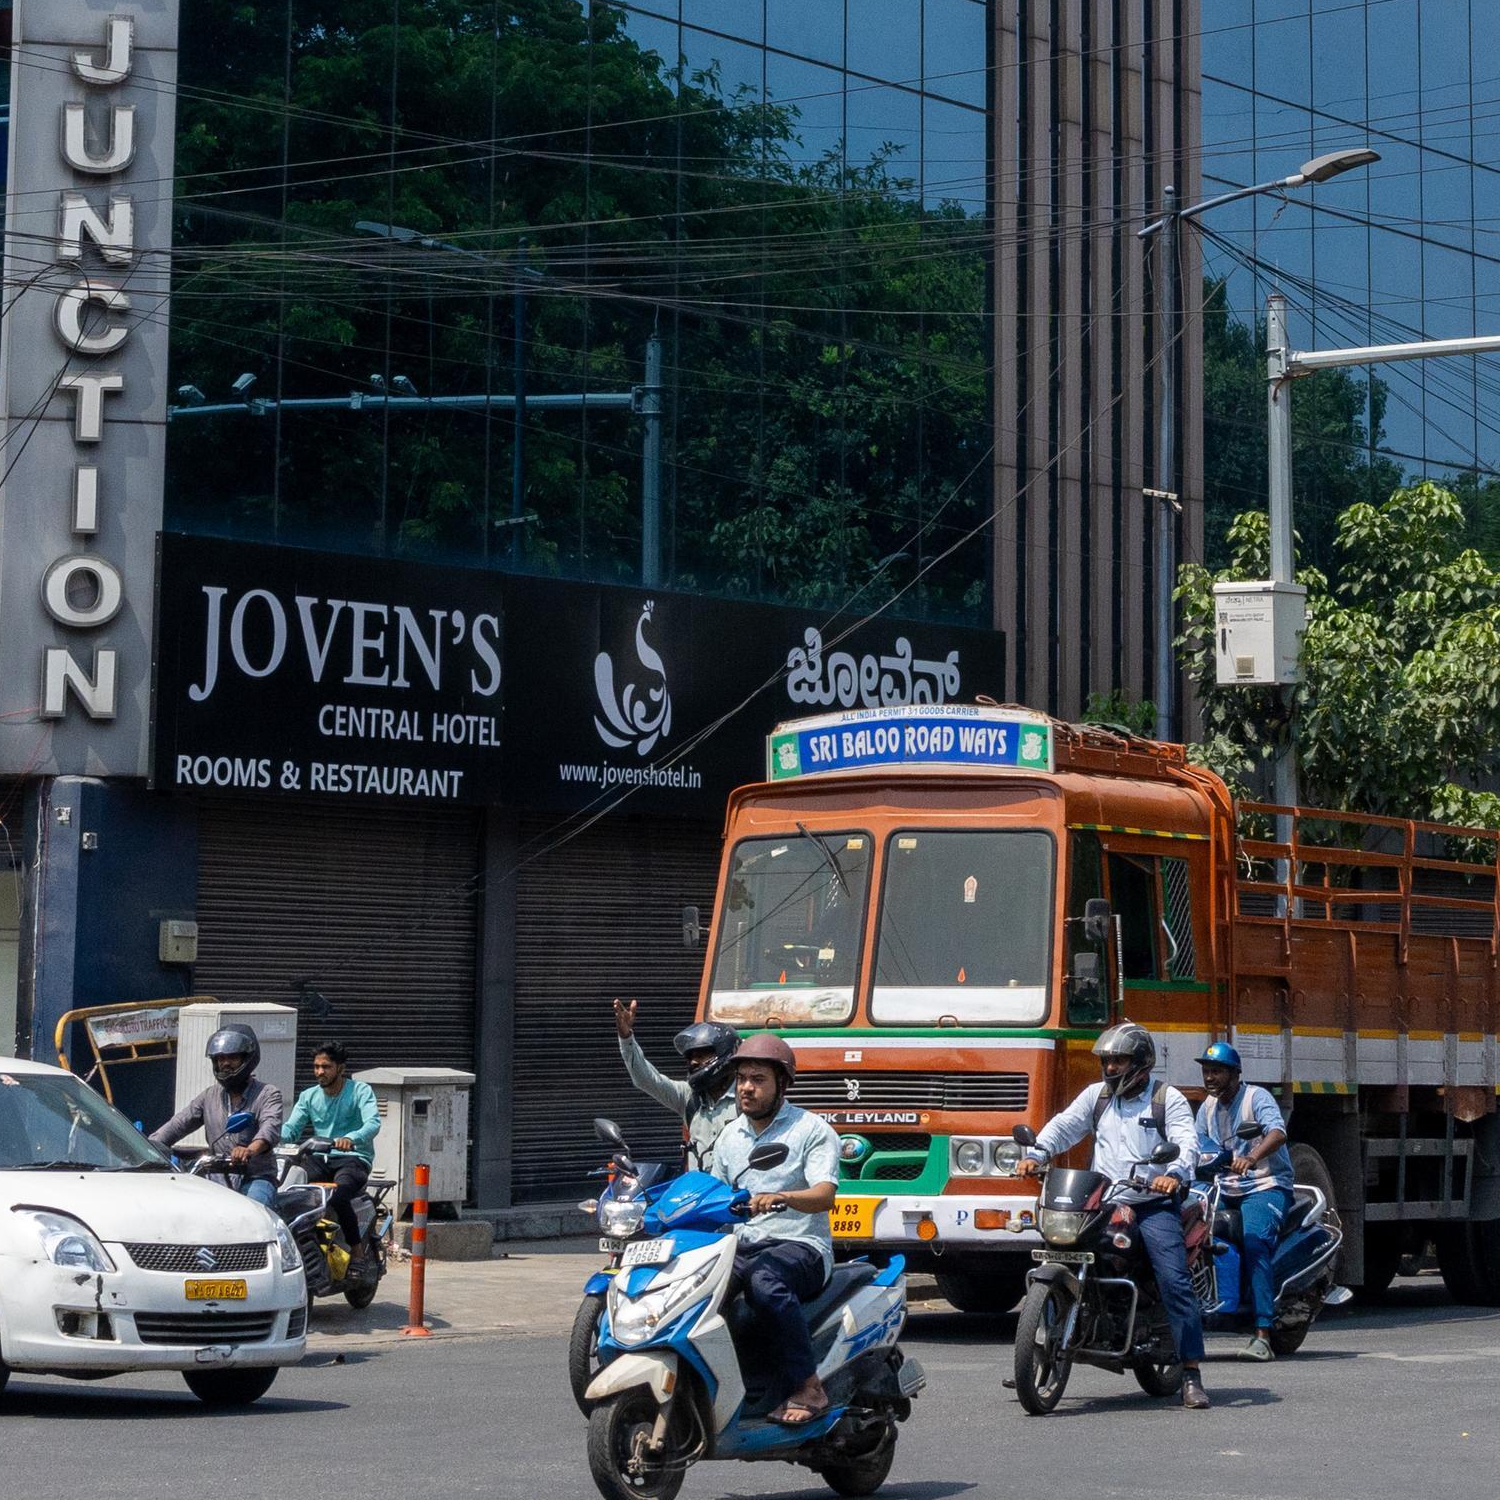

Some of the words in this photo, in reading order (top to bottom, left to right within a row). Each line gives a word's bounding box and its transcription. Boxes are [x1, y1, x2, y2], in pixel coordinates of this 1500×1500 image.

[39, 13, 137, 721] JUNCTION
[188, 585, 502, 702] JOVEN'S
[318, 703, 423, 742] CENTRAL
[432, 712, 501, 747] HOTEL
[857, 710, 877, 720] INDIA
[879, 707, 905, 718] PERMIT
[919, 706, 945, 716] GOODS
[946, 706, 979, 716] CARRIER
[810, 736, 838, 763] SRI
[842, 728, 899, 759] BALOO
[904, 726, 954, 755] ROAD
[959, 726, 1008, 756] WAYS
[176, 754, 272, 789] ROOMS
[280, 760, 302, 791] &
[310, 762, 464, 799] RESTAURANT
[559, 760, 702, 790] www.jovenshotel.in
[846, 1112, 917, 1123] LEYLAND
[833, 1220, 861, 1232] 8889
[845, 1204, 859, 1215] 93
